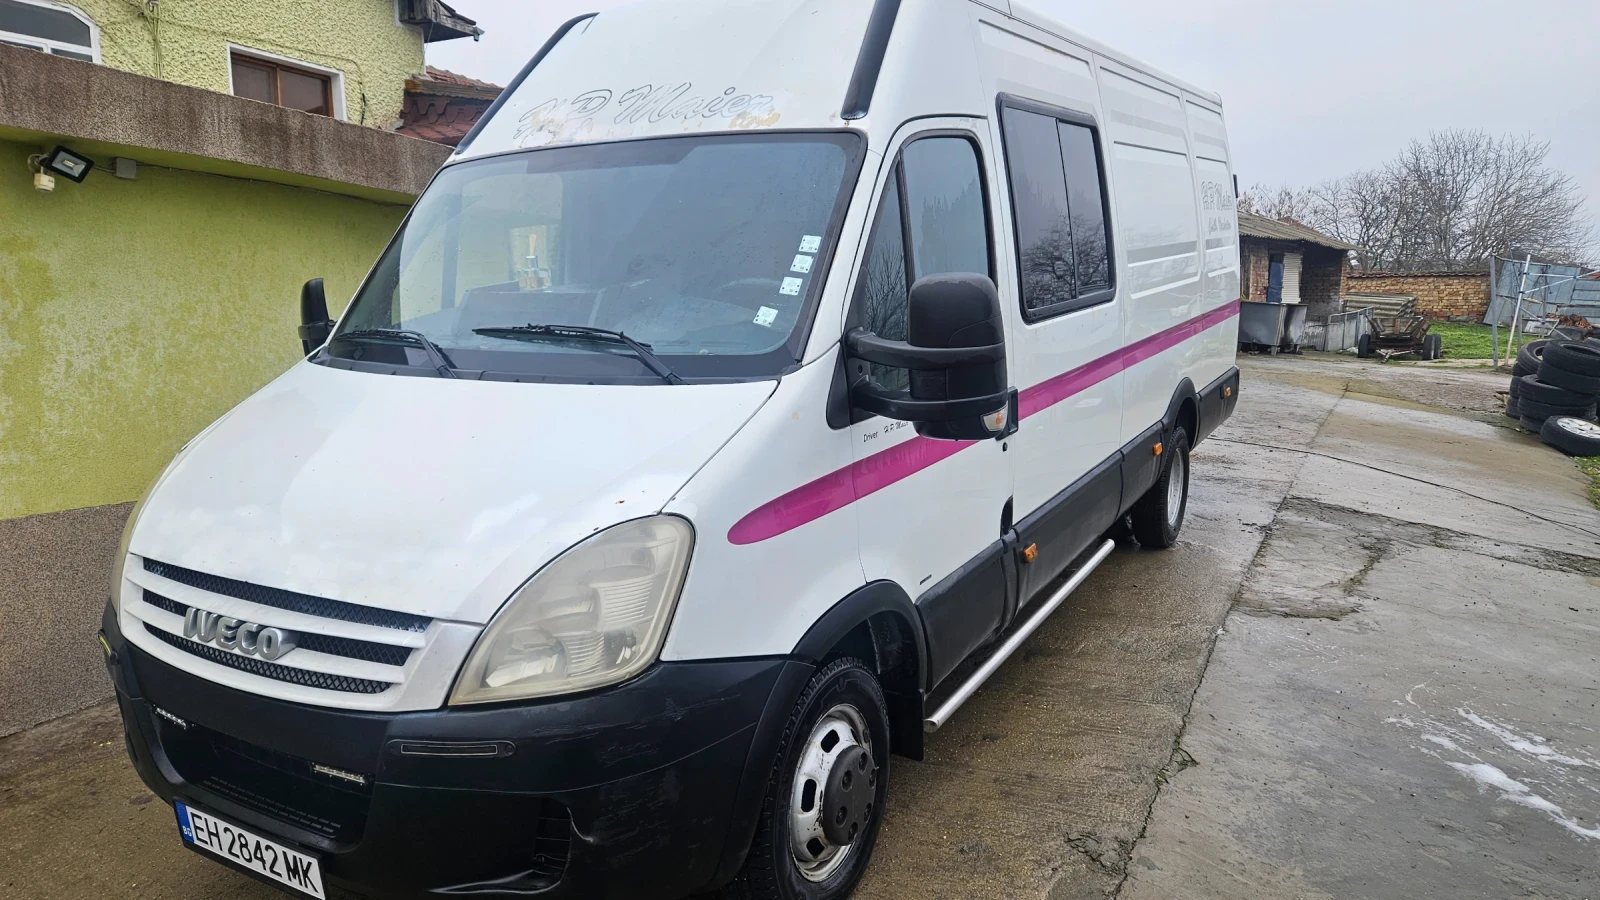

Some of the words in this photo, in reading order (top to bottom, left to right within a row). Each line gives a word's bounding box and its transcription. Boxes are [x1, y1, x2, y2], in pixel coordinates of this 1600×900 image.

[863, 431, 879, 443] Driver
[183, 606, 288, 661] IVECO
[182, 825, 193, 837] BG
